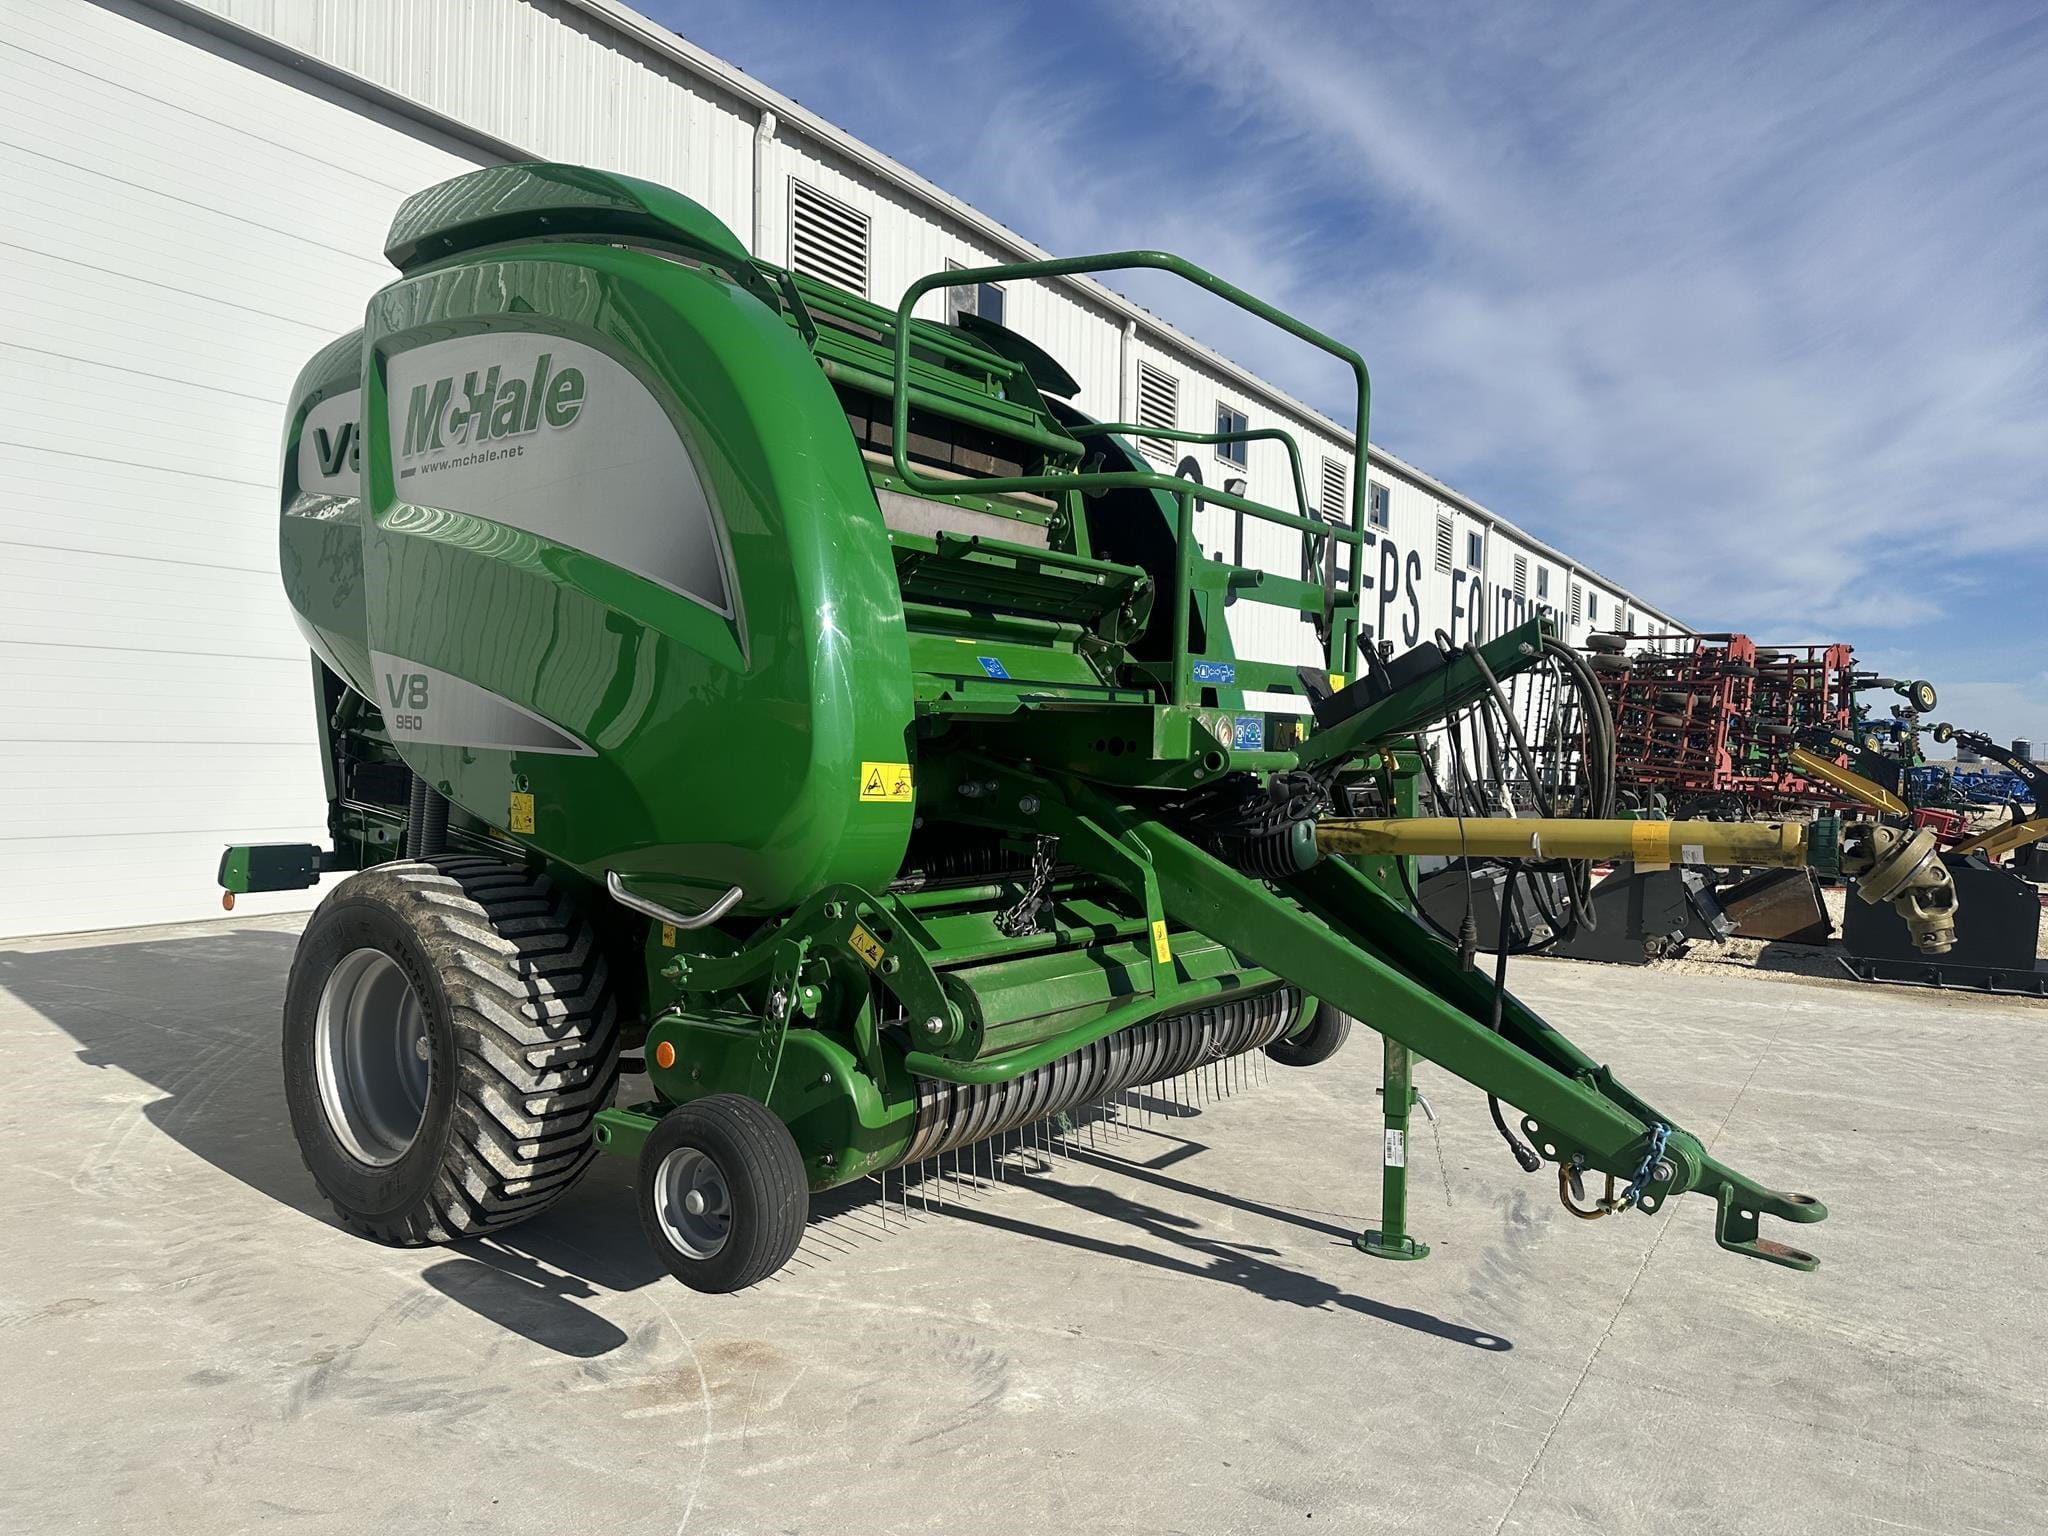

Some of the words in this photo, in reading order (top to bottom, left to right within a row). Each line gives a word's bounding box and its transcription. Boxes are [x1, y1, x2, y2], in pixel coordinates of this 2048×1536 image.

[402, 353, 586, 457] McHale
[421, 445, 524, 474] www.mchale.net
[385, 673, 429, 710] V8
[396, 714, 423, 731] 950
